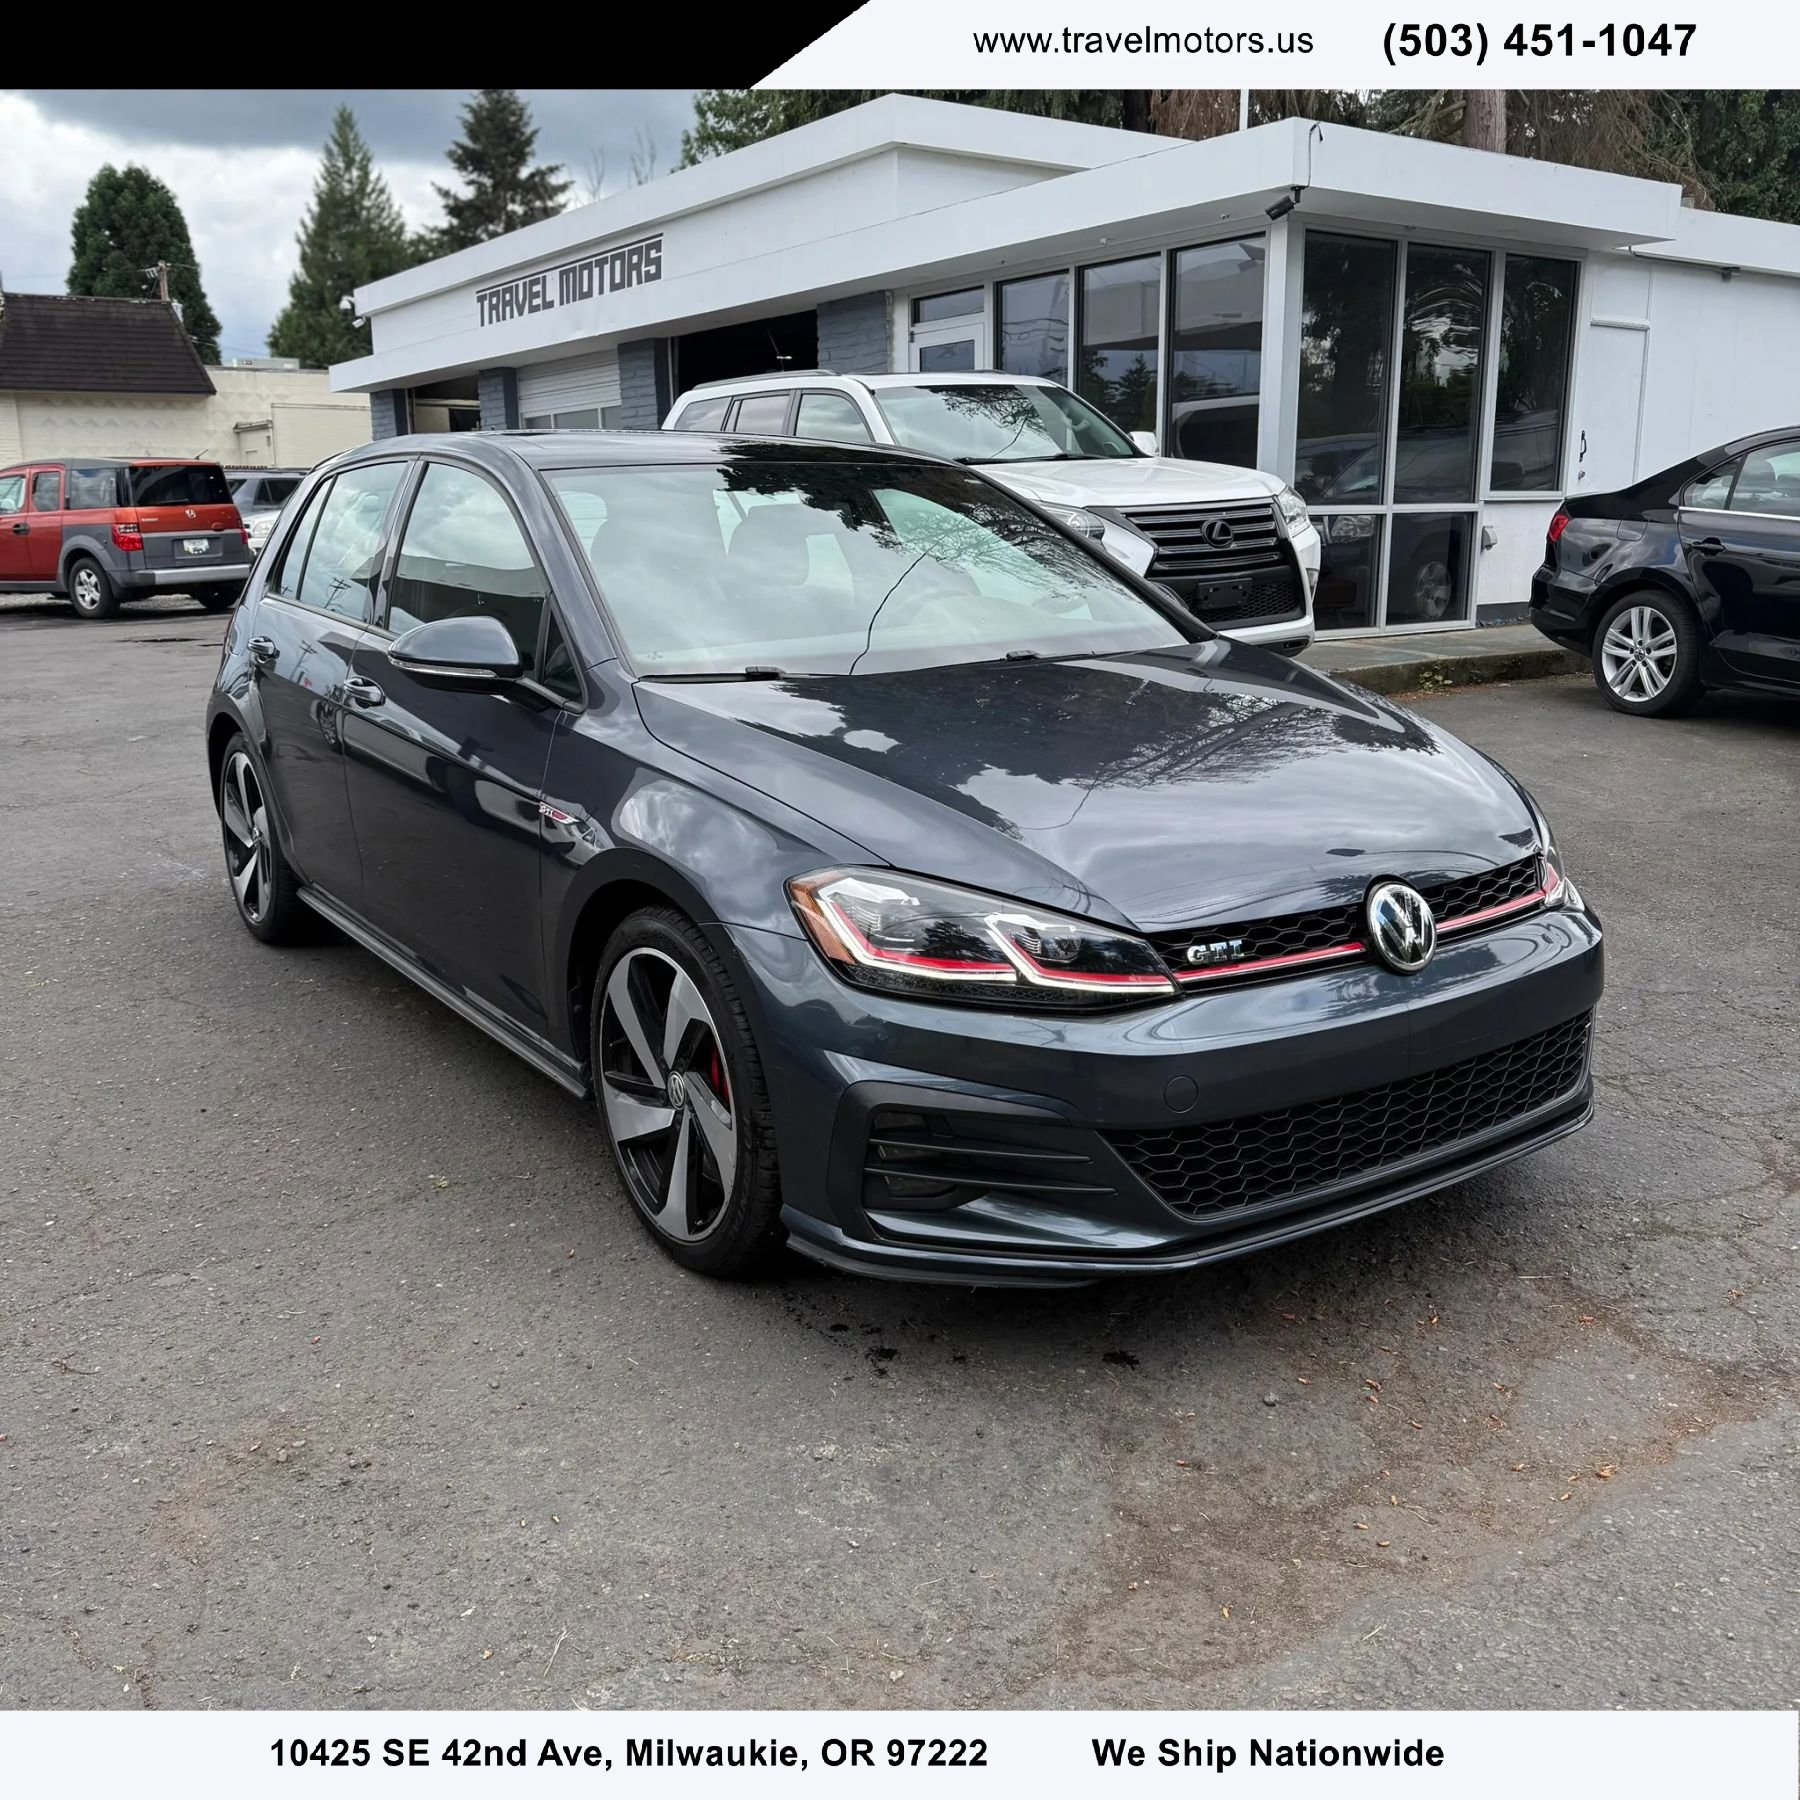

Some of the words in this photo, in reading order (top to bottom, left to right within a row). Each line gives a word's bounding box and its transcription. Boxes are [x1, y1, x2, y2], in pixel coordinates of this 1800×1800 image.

[476, 275, 555, 327] TRAVEL
[558, 239, 662, 306] MOTORS
[1186, 939, 1246, 965] GTI
